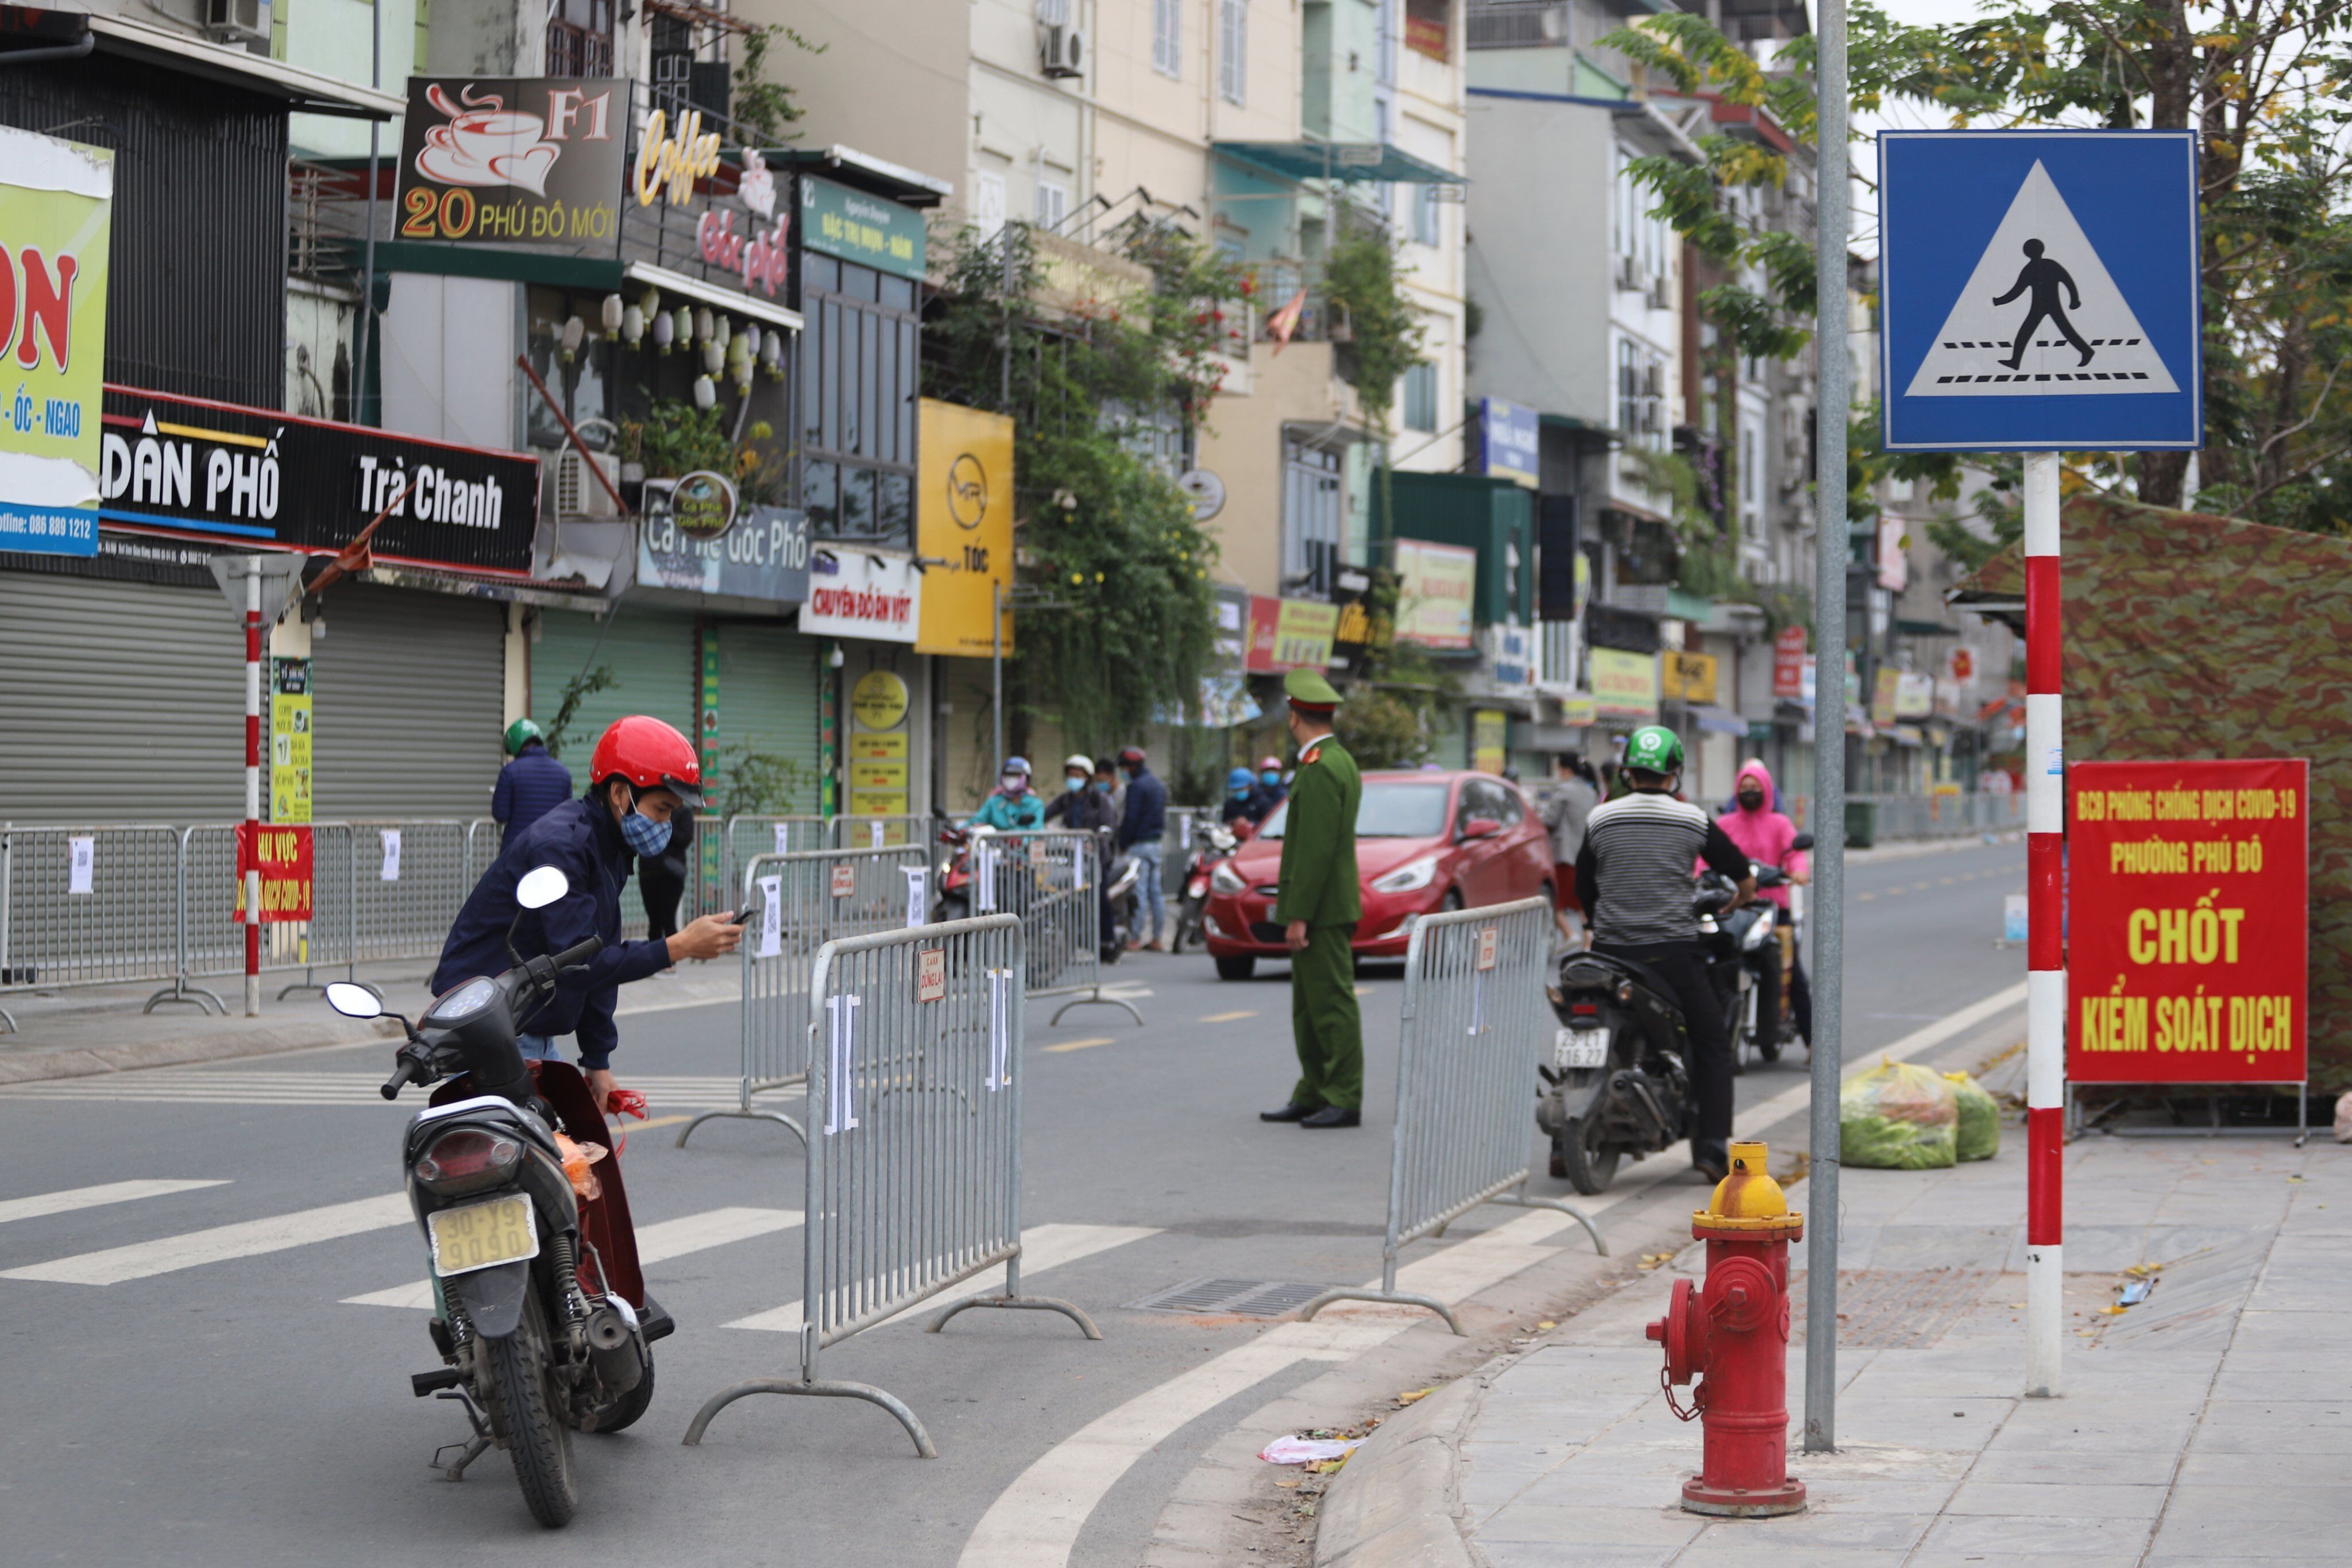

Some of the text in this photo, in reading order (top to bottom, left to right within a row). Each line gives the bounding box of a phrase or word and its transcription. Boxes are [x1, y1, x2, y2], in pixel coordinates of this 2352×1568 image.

[544, 86, 612, 141] F1
[634, 108, 721, 207] Coffee
[401, 186, 615, 238] 20 PHÚ ĐÔ MỚI
[14, 383, 32, 432] ỐC
[45, 399, 80, 439] NGAO
[101, 408, 285, 520] DÂN PHỐ
[360, 455, 503, 530] Trà Chanh
[29, 514, 47, 535] 086
[49, 517, 66, 537] 889
[69, 519, 91, 539] 1212
[770, 517, 810, 570] Phố
[963, 536, 988, 574] TÓC
[2107, 783, 2153, 821] PHÒNG
[2156, 779, 2200, 820] CHỐNG
[2203, 789, 2234, 826] DỊCH
[2237, 788, 2296, 820] COVID-19
[258, 829, 298, 869] HU VỰC
[2111, 833, 2263, 874] PHƯỜNG PHÚ ĐÔ
[2128, 887, 2245, 965] CHỐT
[2081, 973, 2291, 1064] KIỂM SOÁT DỊCH
[450, 1230, 523, 1265] 9090
